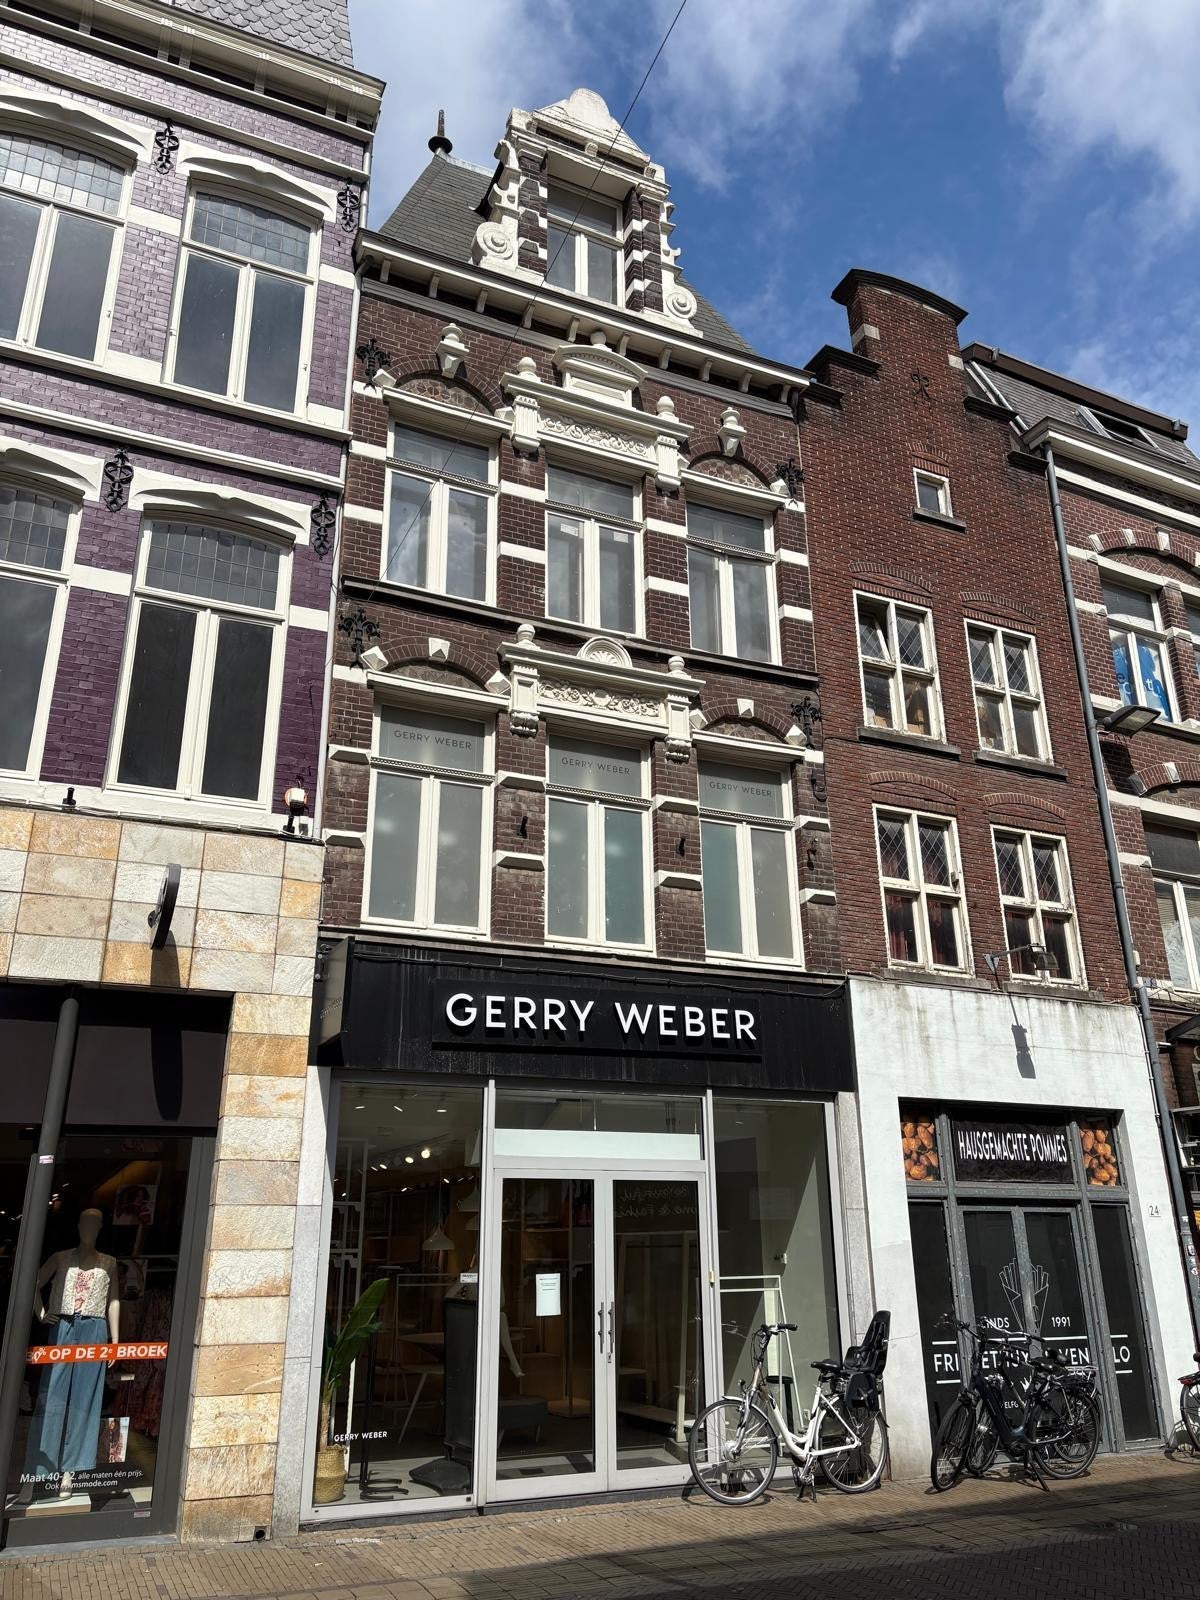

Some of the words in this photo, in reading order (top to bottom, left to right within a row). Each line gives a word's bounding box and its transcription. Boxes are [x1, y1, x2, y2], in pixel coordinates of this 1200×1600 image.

[393, 730, 430, 742] GERRY
[434, 736, 472, 750] WEBER
[561, 757, 593, 769] GERRY
[597, 762, 630, 775] WEBER
[709, 781, 738, 792] GERRY
[742, 786, 772, 797] WEBER
[445, 993, 595, 1032] GERRY
[614, 1002, 757, 1040] WEBER
[957, 1130, 1031, 1161] HAUSGEMACHTE
[1029, 1133, 1068, 1163] POMMES
[1149, 1204, 1160, 1216] 24
[1051, 1316, 1071, 1328] 1991
[49, 1348, 71, 1360] OP
[75, 1347, 96, 1359] DE
[116, 1344, 168, 1358] BROEK
[334, 1433, 360, 1442] GERRY
[361, 1431, 388, 1439] WEBER
[19, 1473, 46, 1484] Maat
[47, 1471, 77, 1482] 40-2,
[91, 1471, 113, 1480] maten
[113, 1470, 127, 1478] één
[127, 1470, 144, 1479] prijs.
[45, 1482, 59, 1490] Ook
